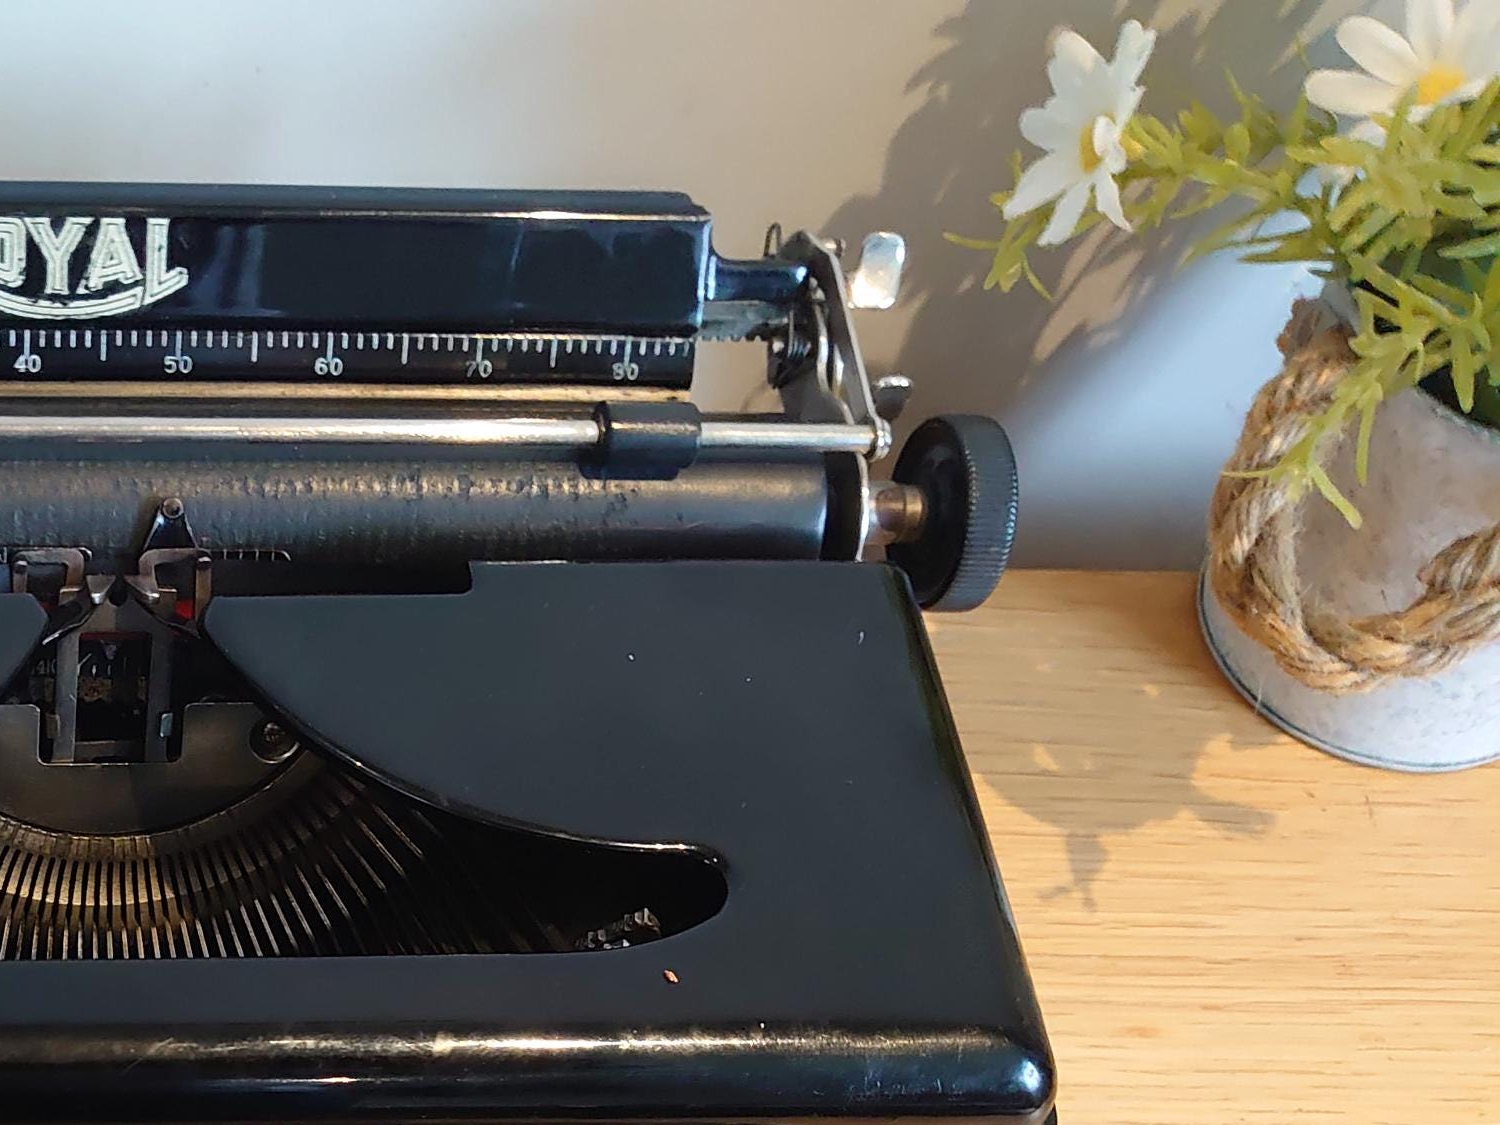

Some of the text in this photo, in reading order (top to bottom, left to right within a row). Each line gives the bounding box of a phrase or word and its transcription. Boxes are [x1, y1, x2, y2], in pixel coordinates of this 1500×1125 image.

[14, 354, 41, 373] 40
[164, 354, 192, 374] 50
[315, 355, 343, 376] 60
[466, 358, 492, 378] 70
[613, 360, 638, 381] 80
